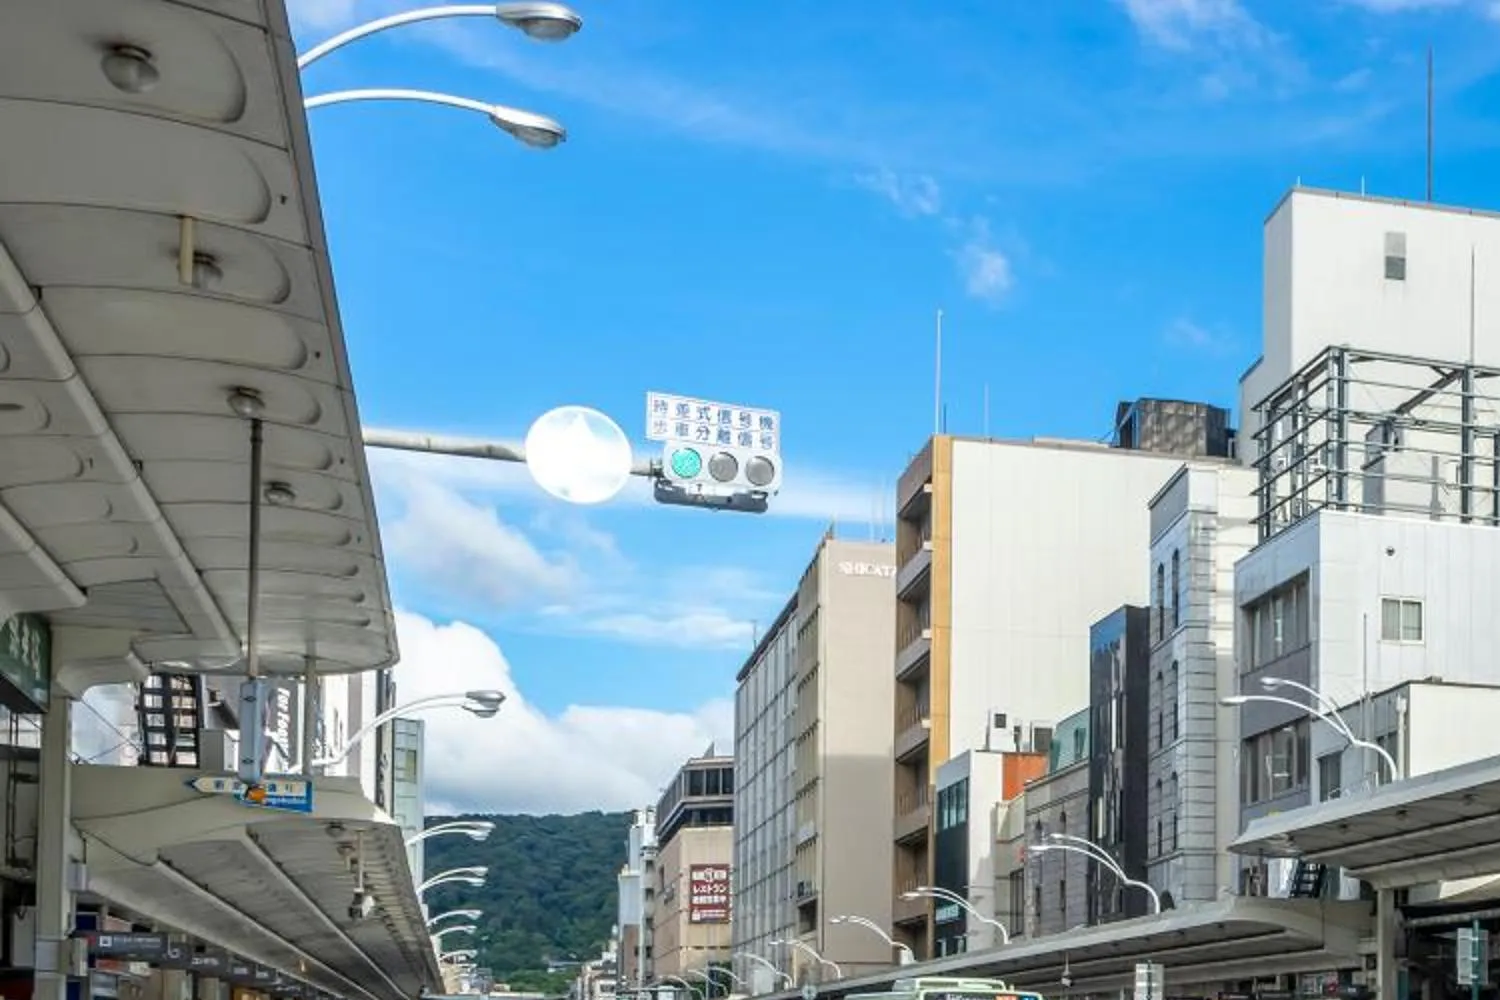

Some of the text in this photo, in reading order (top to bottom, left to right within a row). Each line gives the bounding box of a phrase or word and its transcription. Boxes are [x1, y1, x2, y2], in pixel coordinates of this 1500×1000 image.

[693, 883, 727, 895] レストラン
